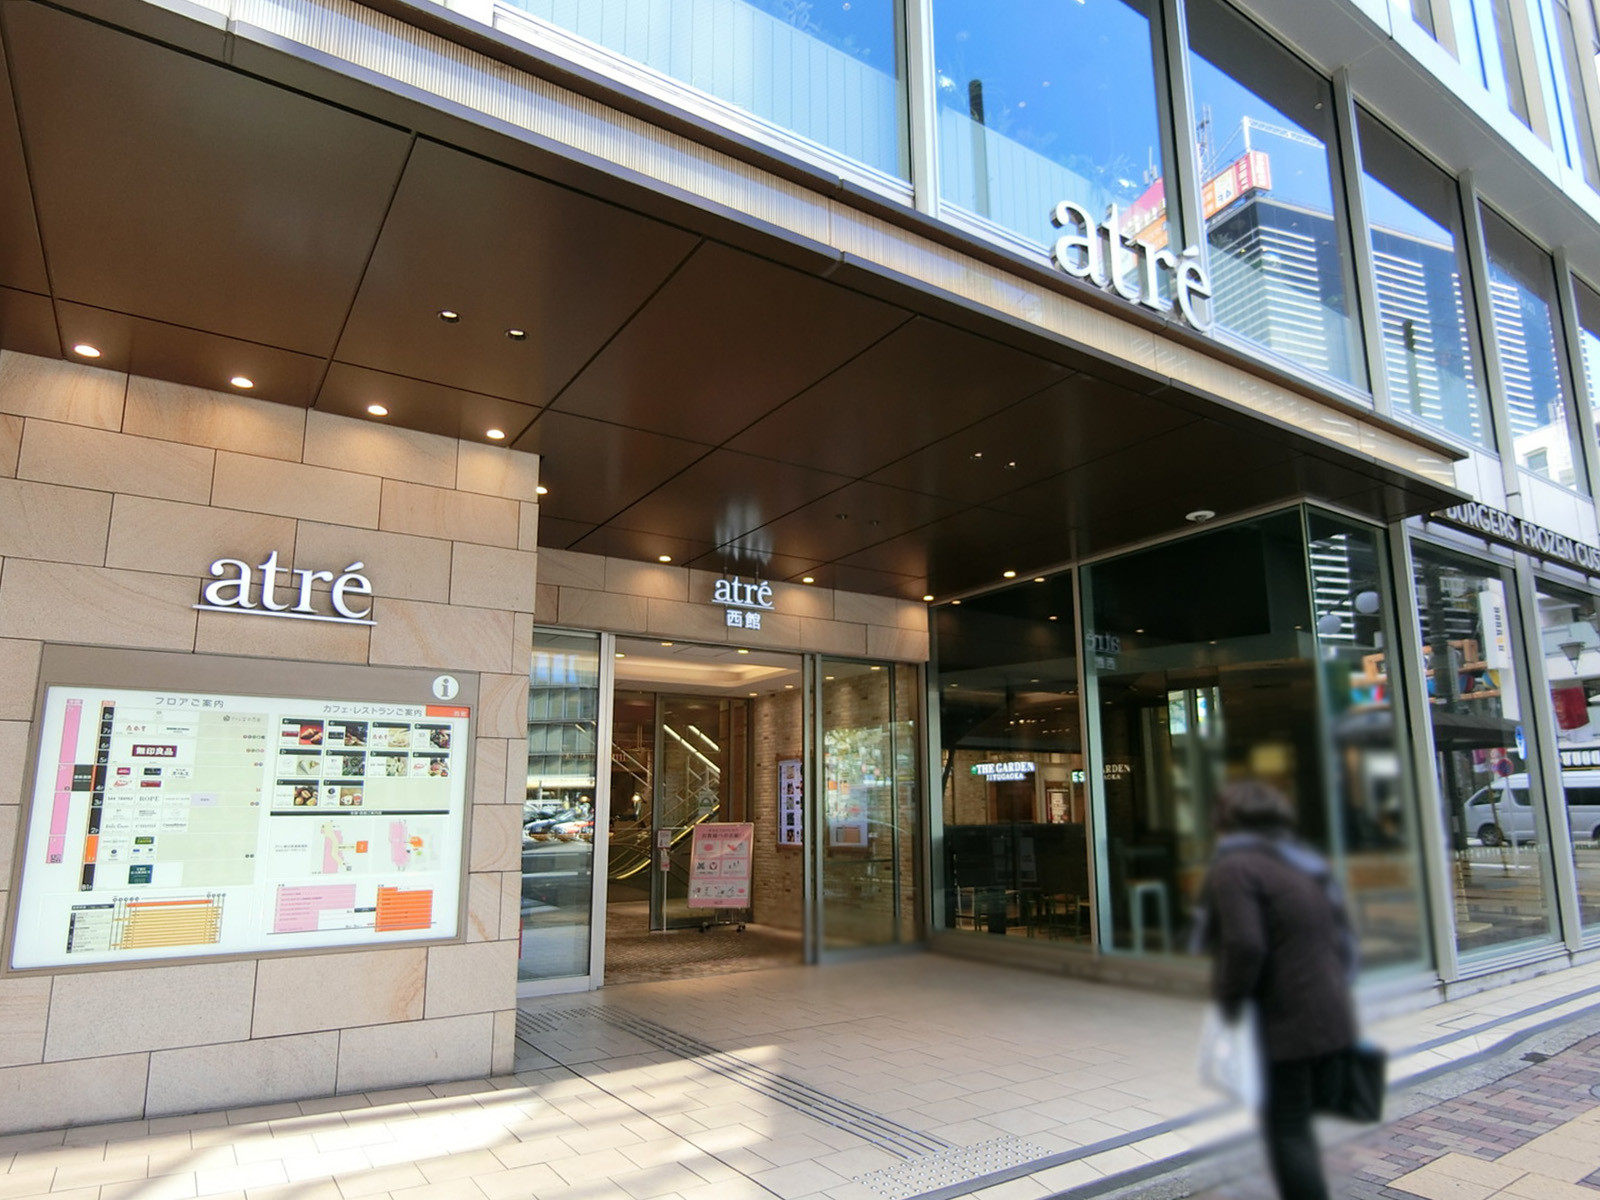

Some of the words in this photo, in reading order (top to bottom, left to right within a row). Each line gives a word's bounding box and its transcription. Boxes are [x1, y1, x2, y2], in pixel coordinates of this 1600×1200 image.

[1051, 199, 1212, 332] atré
[1520, 520, 1575, 560] FROZEN
[203, 550, 372, 619] atré
[714, 576, 773, 607] atré
[726, 609, 761, 631] 西館
[155, 696, 225, 709] フロアご案内
[975, 763, 995, 775] THE
[995, 761, 1035, 773] GARDEN
